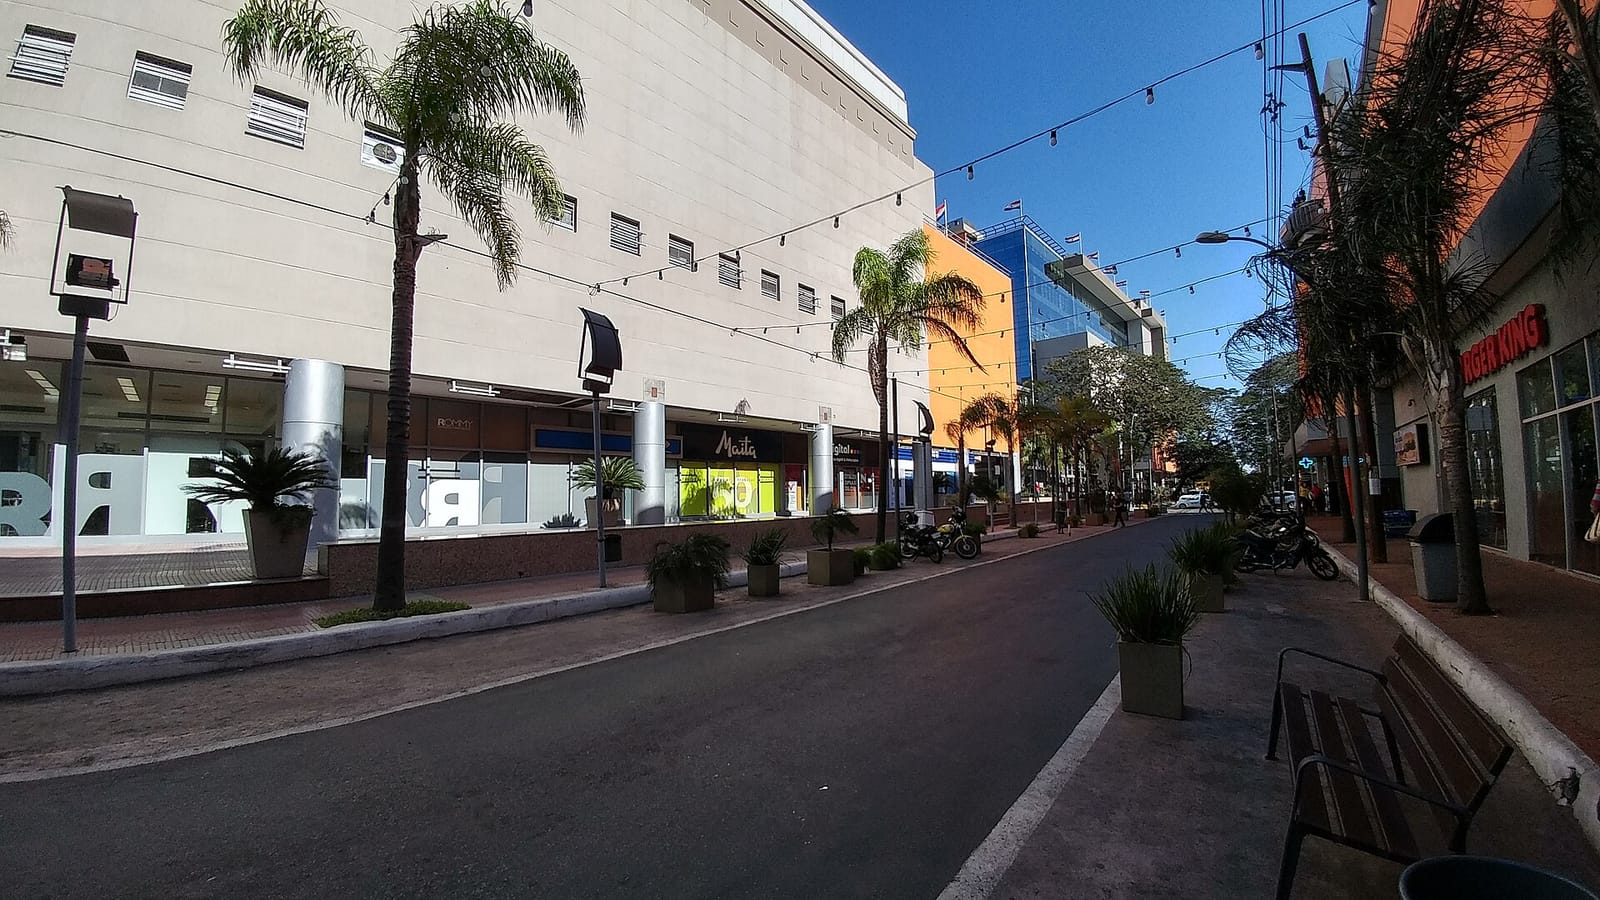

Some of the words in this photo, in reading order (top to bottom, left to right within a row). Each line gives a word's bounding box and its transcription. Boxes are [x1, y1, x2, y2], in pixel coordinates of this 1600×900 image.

[1459, 335, 1498, 385] RGER
[1497, 304, 1547, 366] KING
[437, 416, 473, 429] ROMMY
[715, 430, 757, 458] Maita
